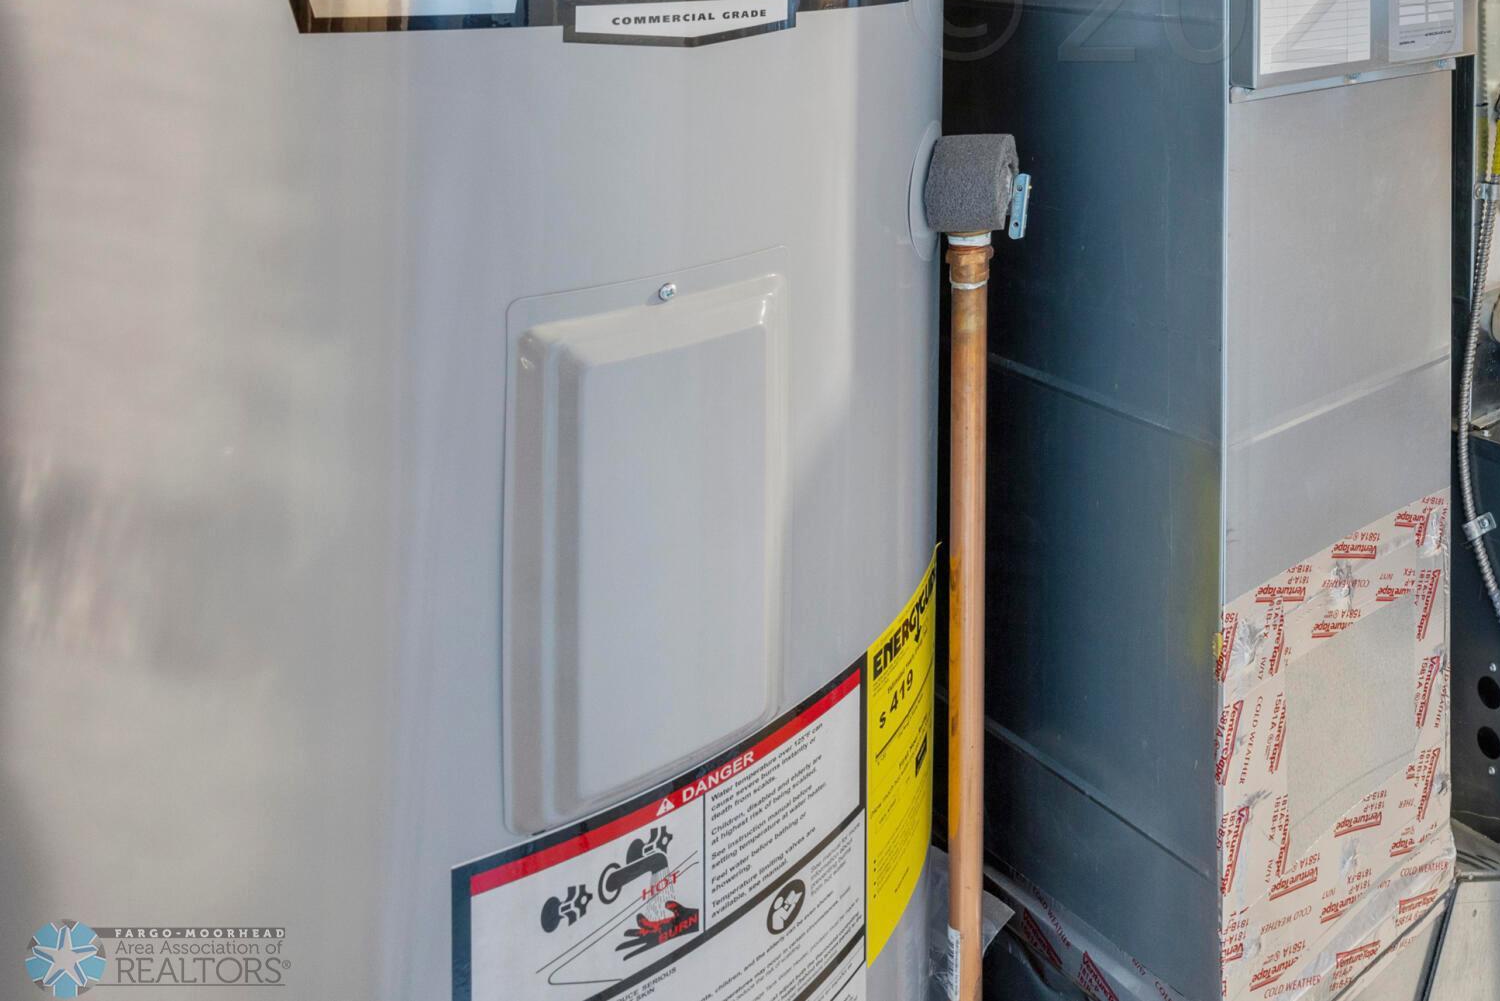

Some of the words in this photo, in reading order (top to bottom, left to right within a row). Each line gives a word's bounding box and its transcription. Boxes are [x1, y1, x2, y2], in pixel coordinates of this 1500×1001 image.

[611, 12, 716, 26] COMMERCIAL
[722, 9, 768, 20] GRADE
[1331, 543, 1377, 554] VentureTape
[1255, 586, 1306, 597] VentureTape
[1416, 568, 1441, 642] VentureTape
[682, 751, 755, 803] DANGER
[711, 795, 734, 812] cause
[735, 778, 760, 797] severe
[760, 763, 781, 780] burns
[781, 743, 809, 766] instantly
[711, 784, 734, 802] Water
[735, 756, 777, 787] temperature
[747, 788, 777, 813] disabled
[790, 763, 812, 784] elderly
[711, 804, 733, 821] death
[734, 792, 752, 807] from
[727, 820, 767, 851] instruction
[767, 800, 792, 821] manual
[792, 784, 814, 803] before
[1335, 811, 1383, 831] VentureTape
[720, 816, 750, 839] highest
[751, 838, 774, 858] before
[774, 818, 799, 839] bathing
[711, 848, 738, 870] setting
[739, 818, 781, 849] temperature
[711, 873, 758, 908] Temperature
[758, 854, 784, 876] limiting
[785, 836, 806, 855] valves
[1268, 866, 1319, 894] VentureTape
[1400, 866, 1418, 878] COLD
[1417, 861, 1449, 874] WEATHER
[641, 871, 680, 901] HOT
[657, 914, 698, 945] BURN
[642, 967, 677, 991] SERIOUS
[1264, 982, 1284, 999] COLD
[1284, 974, 1322, 994] WEATHER
